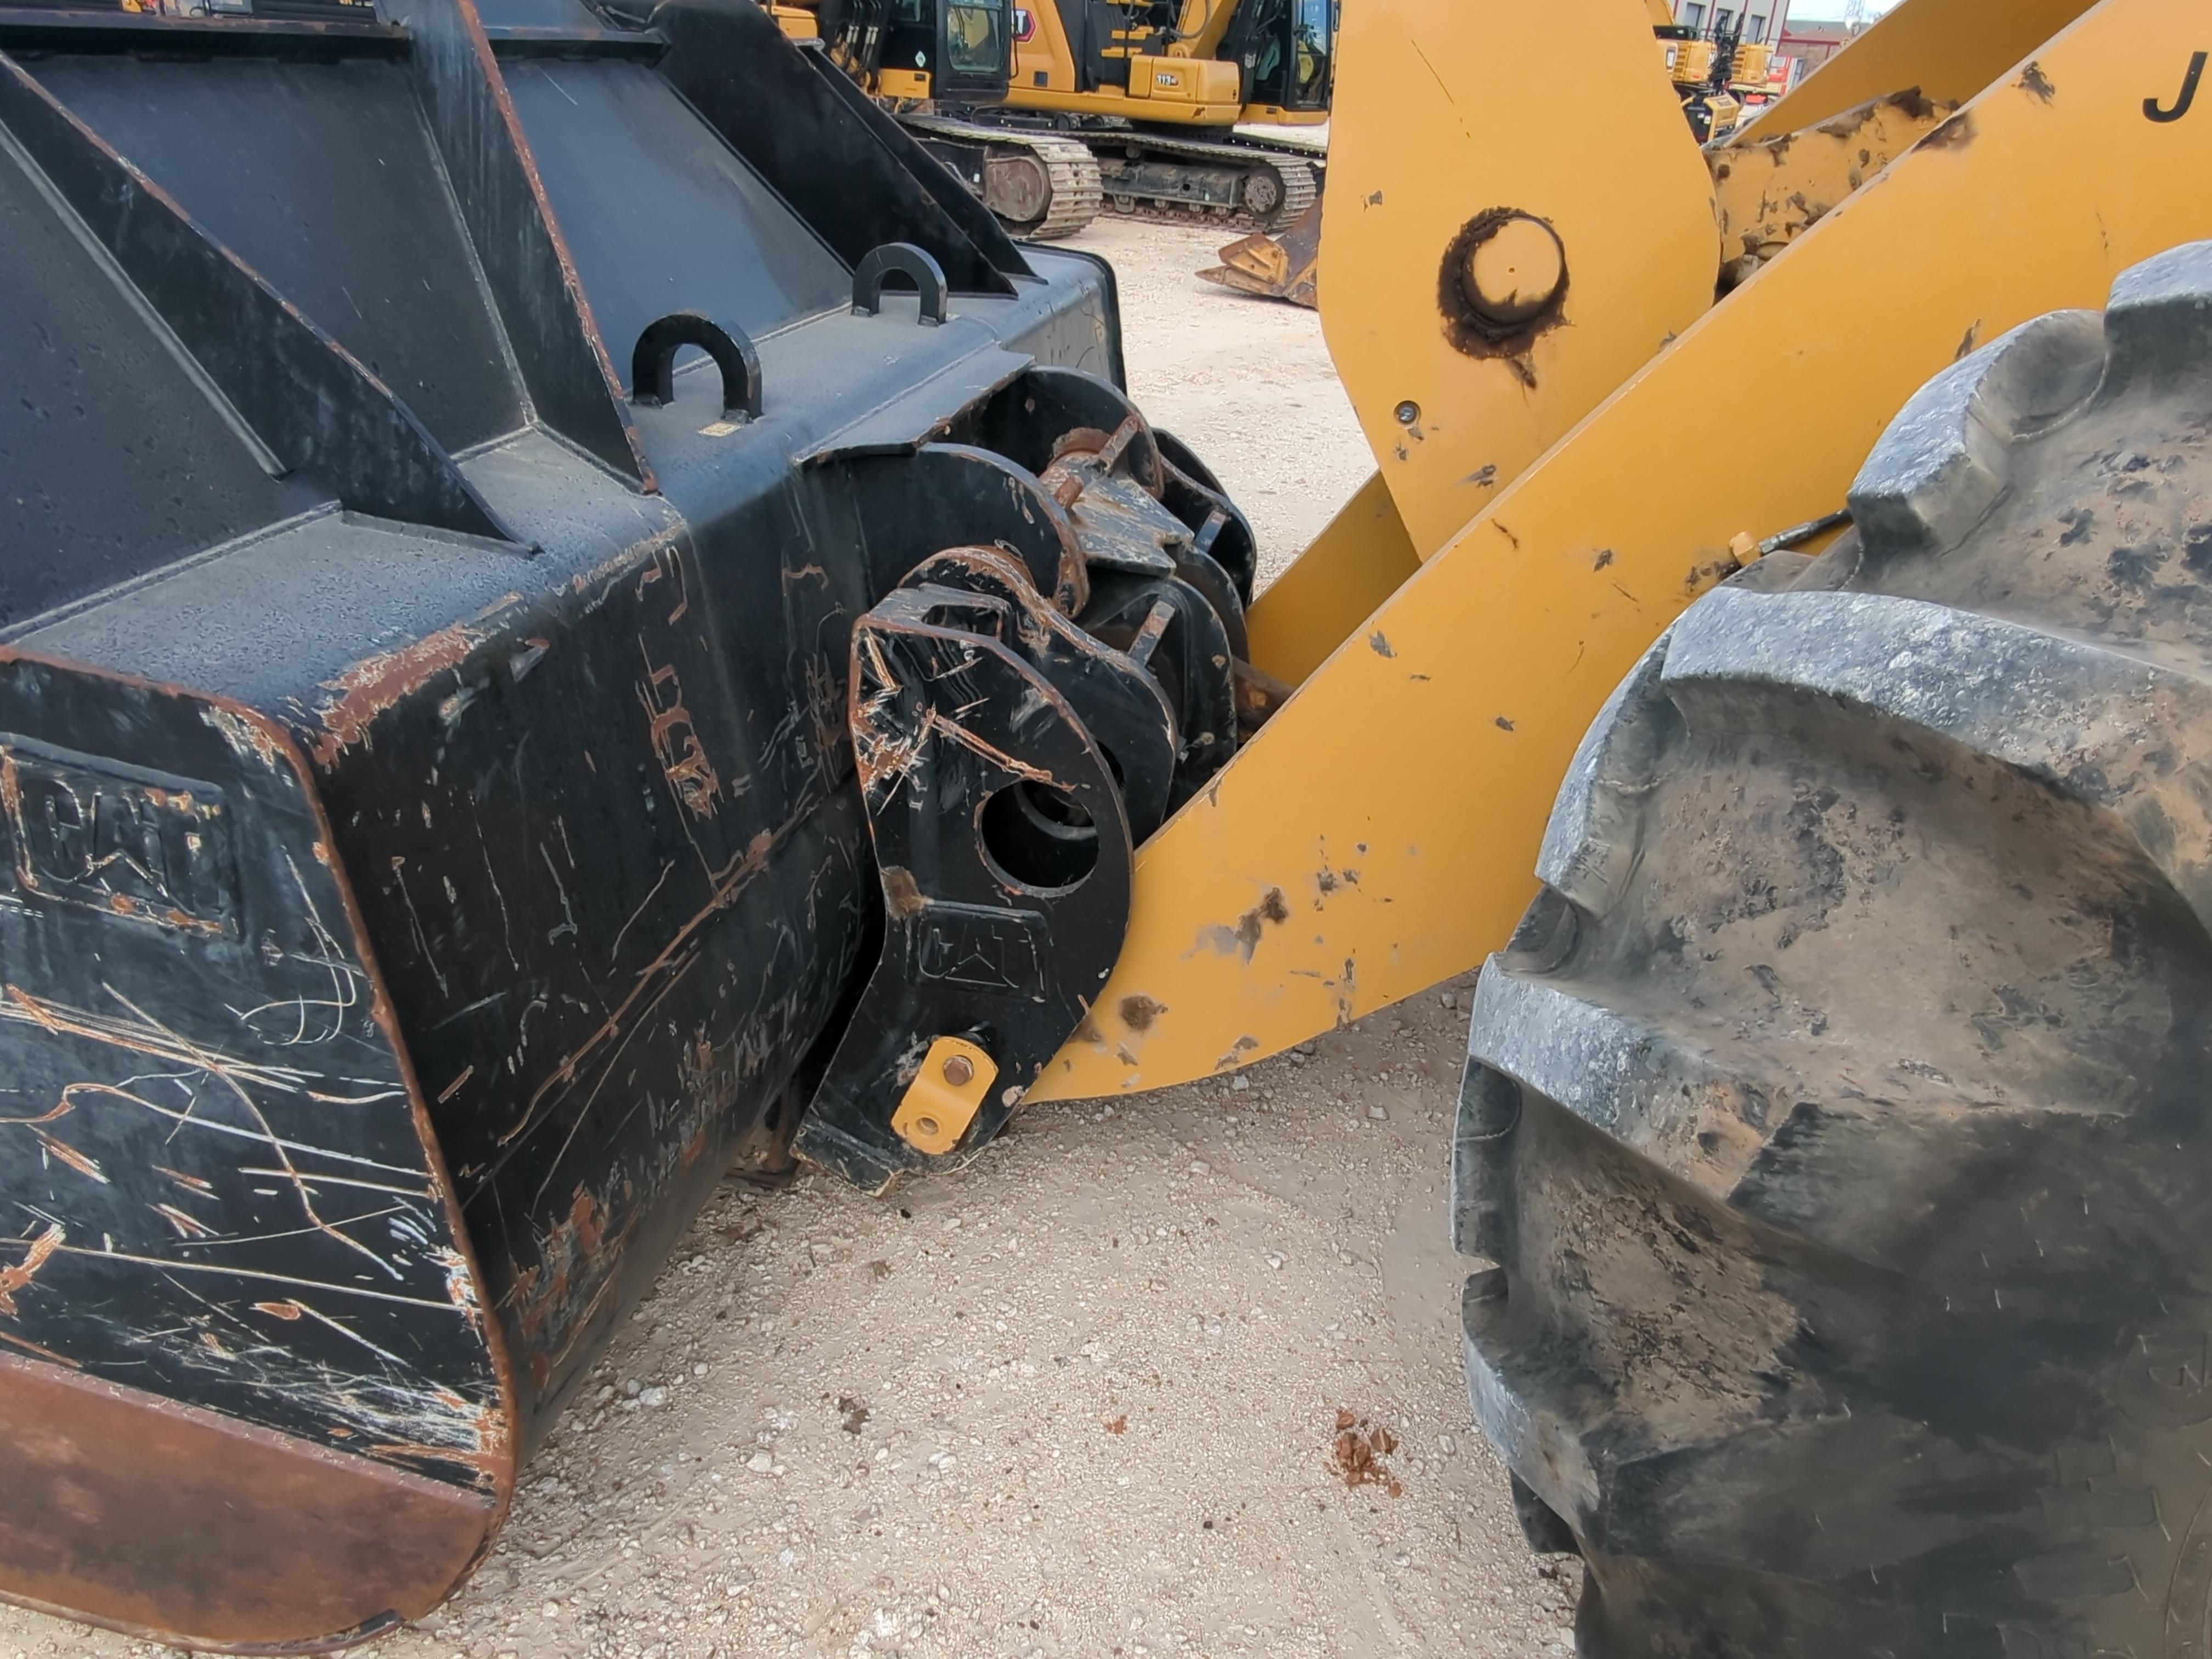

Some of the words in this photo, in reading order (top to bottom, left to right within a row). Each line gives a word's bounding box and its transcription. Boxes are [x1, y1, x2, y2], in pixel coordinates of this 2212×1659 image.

[2142, 50, 2209, 123] J
[20, 778, 204, 916] CAT
[919, 922, 1031, 988] CAT
